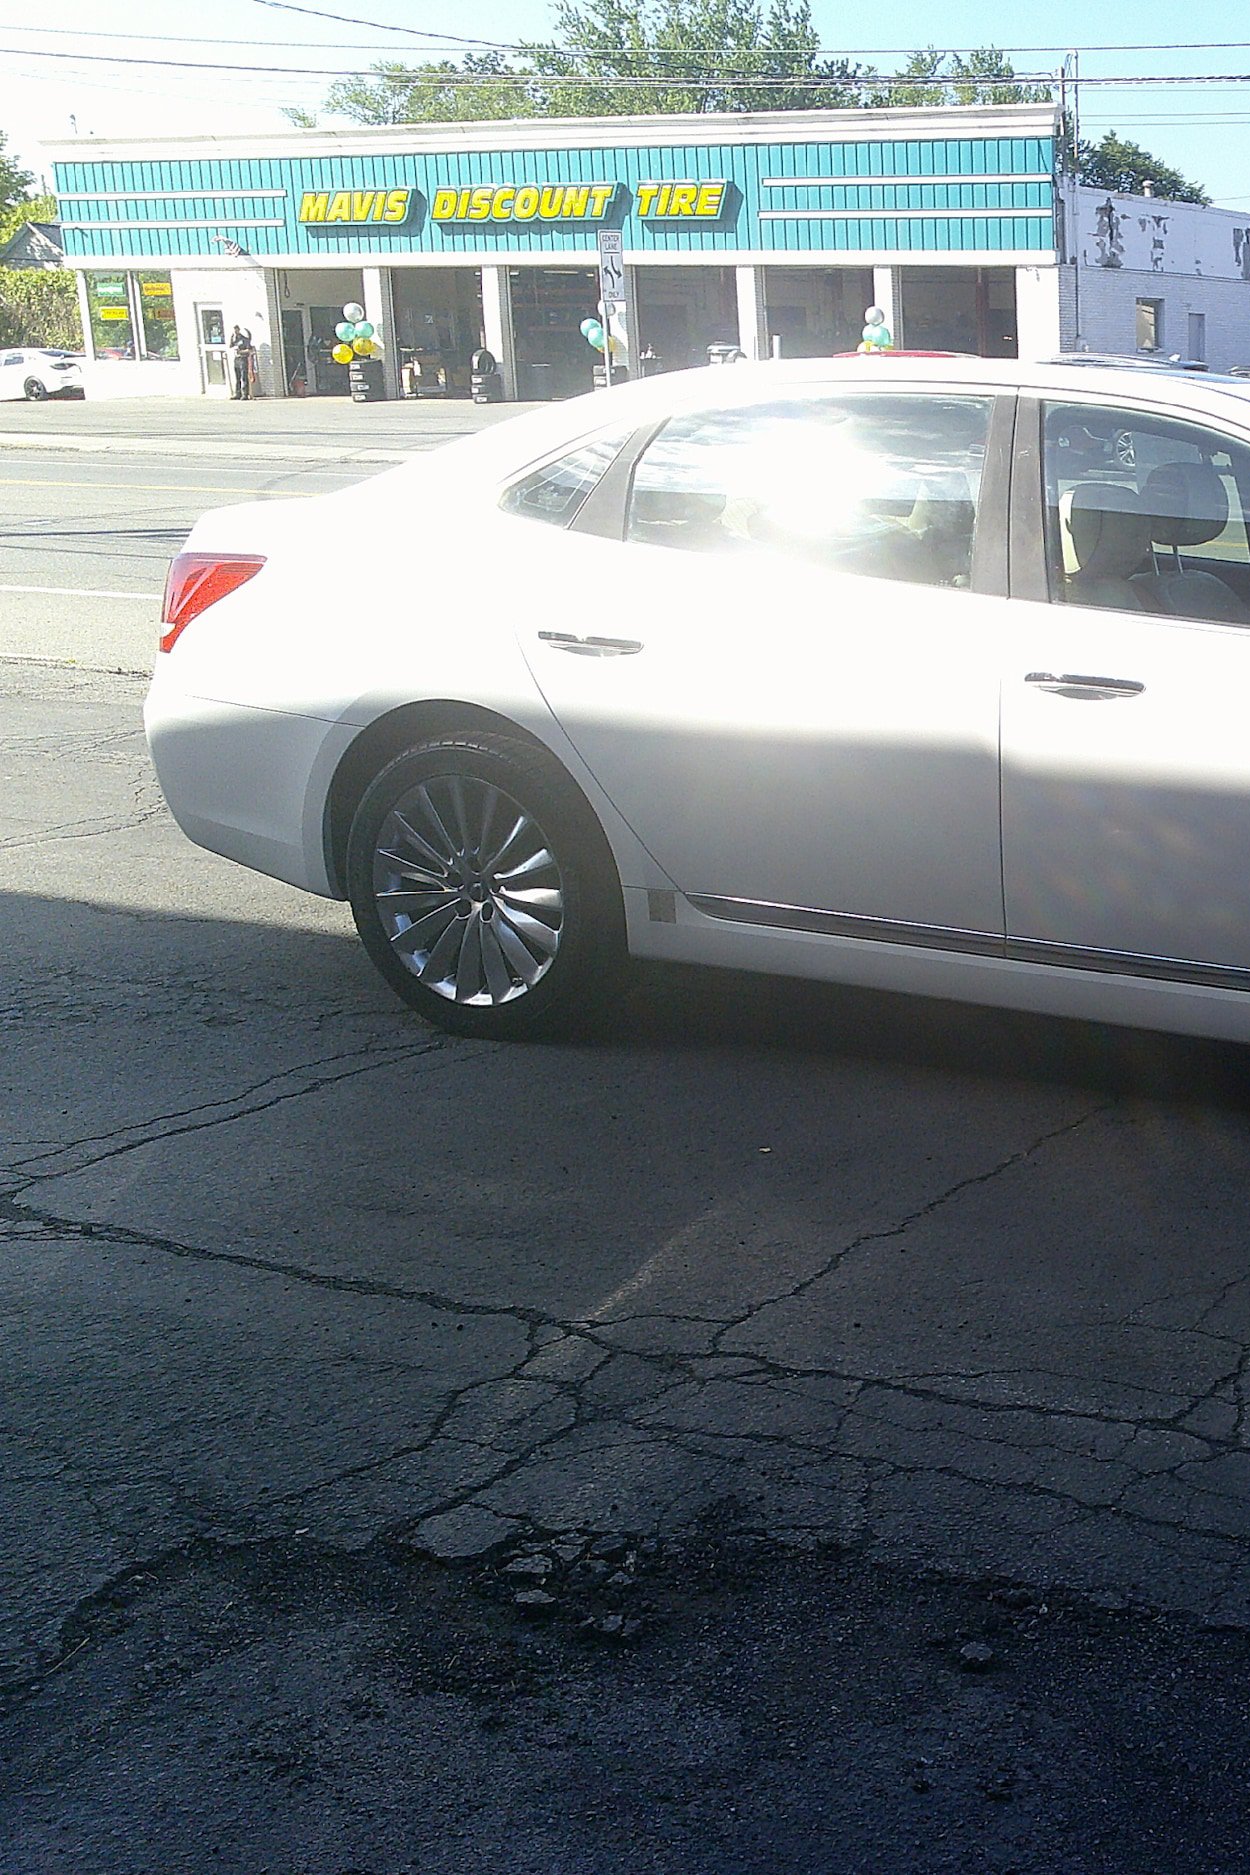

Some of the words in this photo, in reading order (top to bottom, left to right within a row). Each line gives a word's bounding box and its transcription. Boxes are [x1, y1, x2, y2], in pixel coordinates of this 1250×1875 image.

[299, 189, 409, 222] MAVIS
[431, 185, 615, 220] DISCOUNT
[636, 183, 726, 217] TIRE
